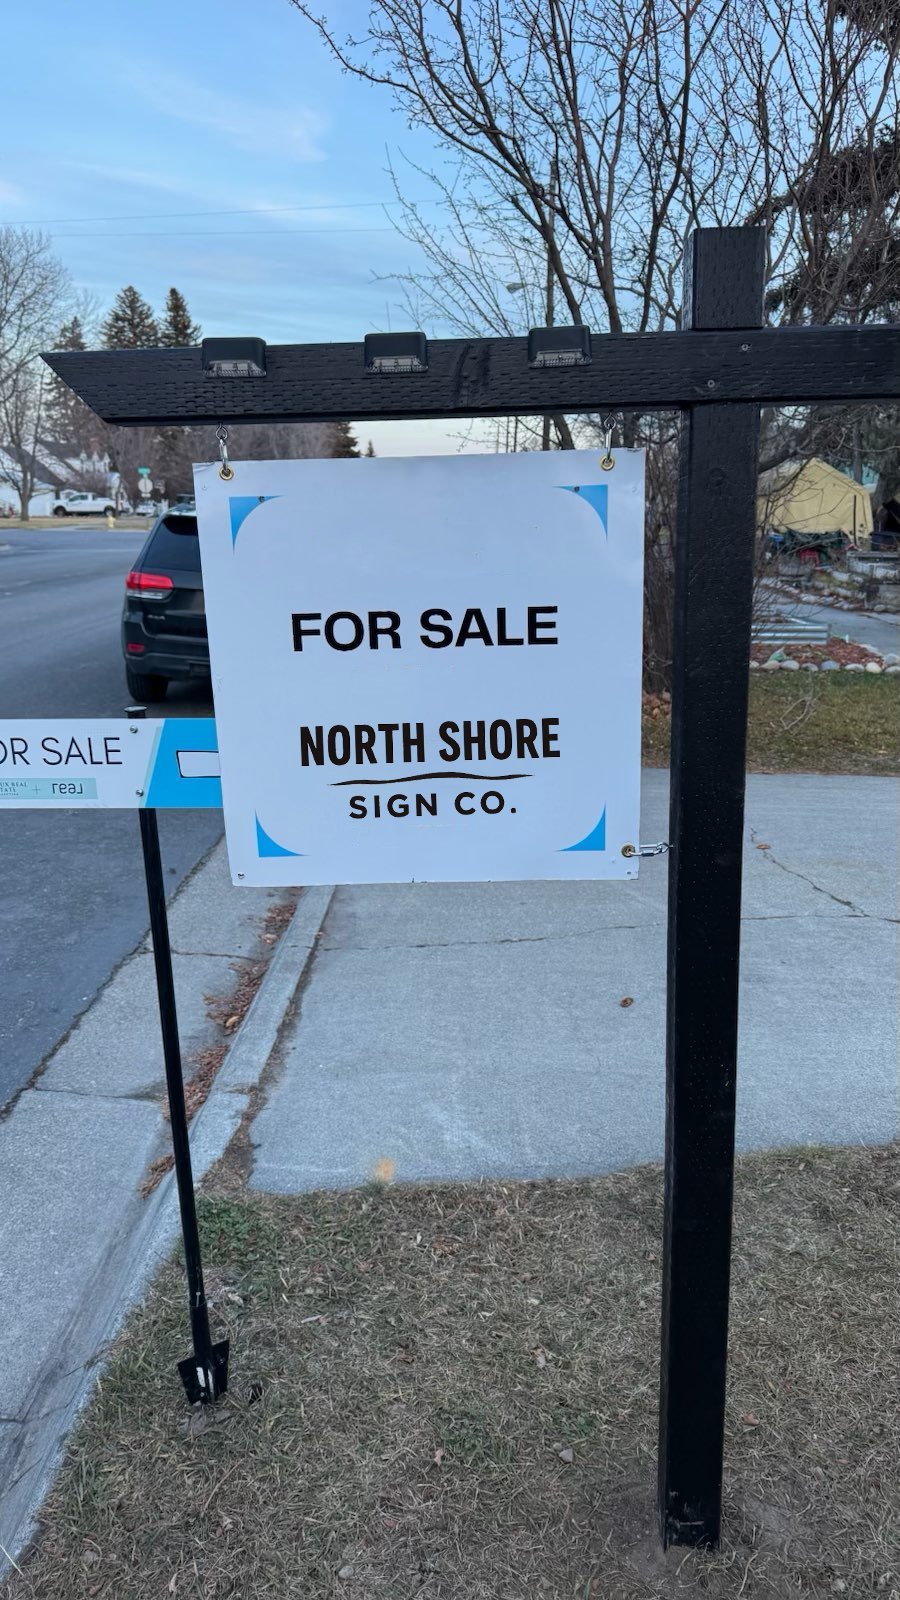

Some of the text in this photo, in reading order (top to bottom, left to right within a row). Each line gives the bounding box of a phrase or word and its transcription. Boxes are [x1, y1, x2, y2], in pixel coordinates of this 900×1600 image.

[291, 605, 559, 652] FOR SALE
[41, 736, 123, 765] SALE
[299, 717, 561, 767] NORTH SHORE
[348, 790, 517, 819] SIGN CO.
